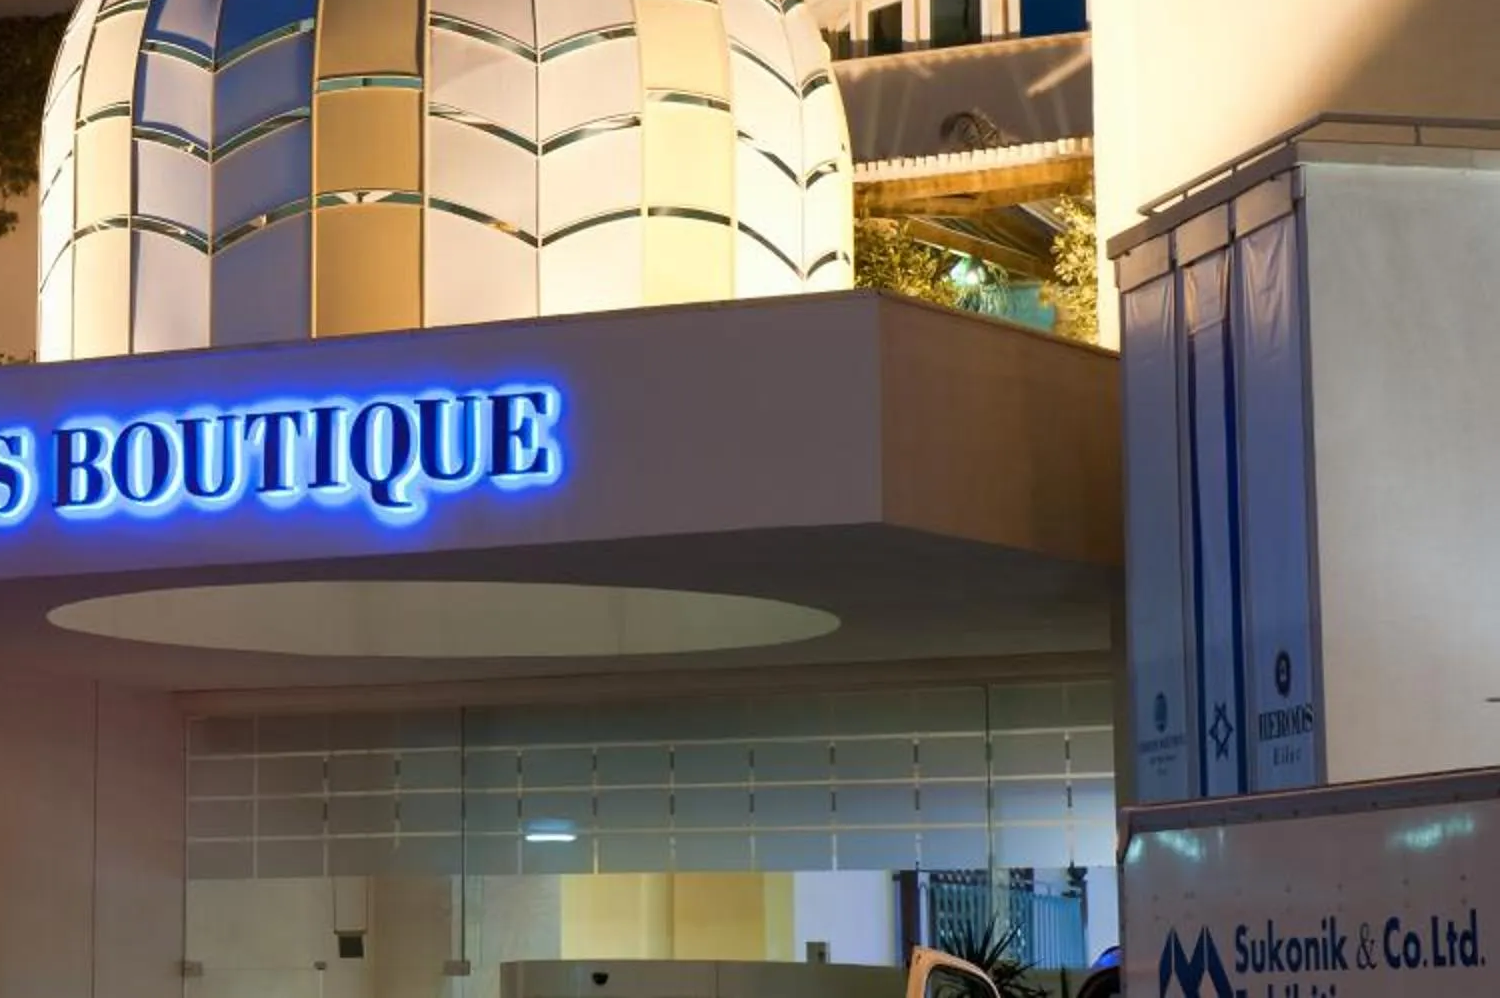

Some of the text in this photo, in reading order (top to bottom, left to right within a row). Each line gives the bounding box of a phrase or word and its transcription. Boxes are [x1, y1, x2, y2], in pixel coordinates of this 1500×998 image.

[51, 390, 553, 510] BOUTIQUE
[1258, 702, 1315, 742] HERODS
[1235, 914, 1350, 974] Sukonik
[1355, 921, 1378, 971] &
